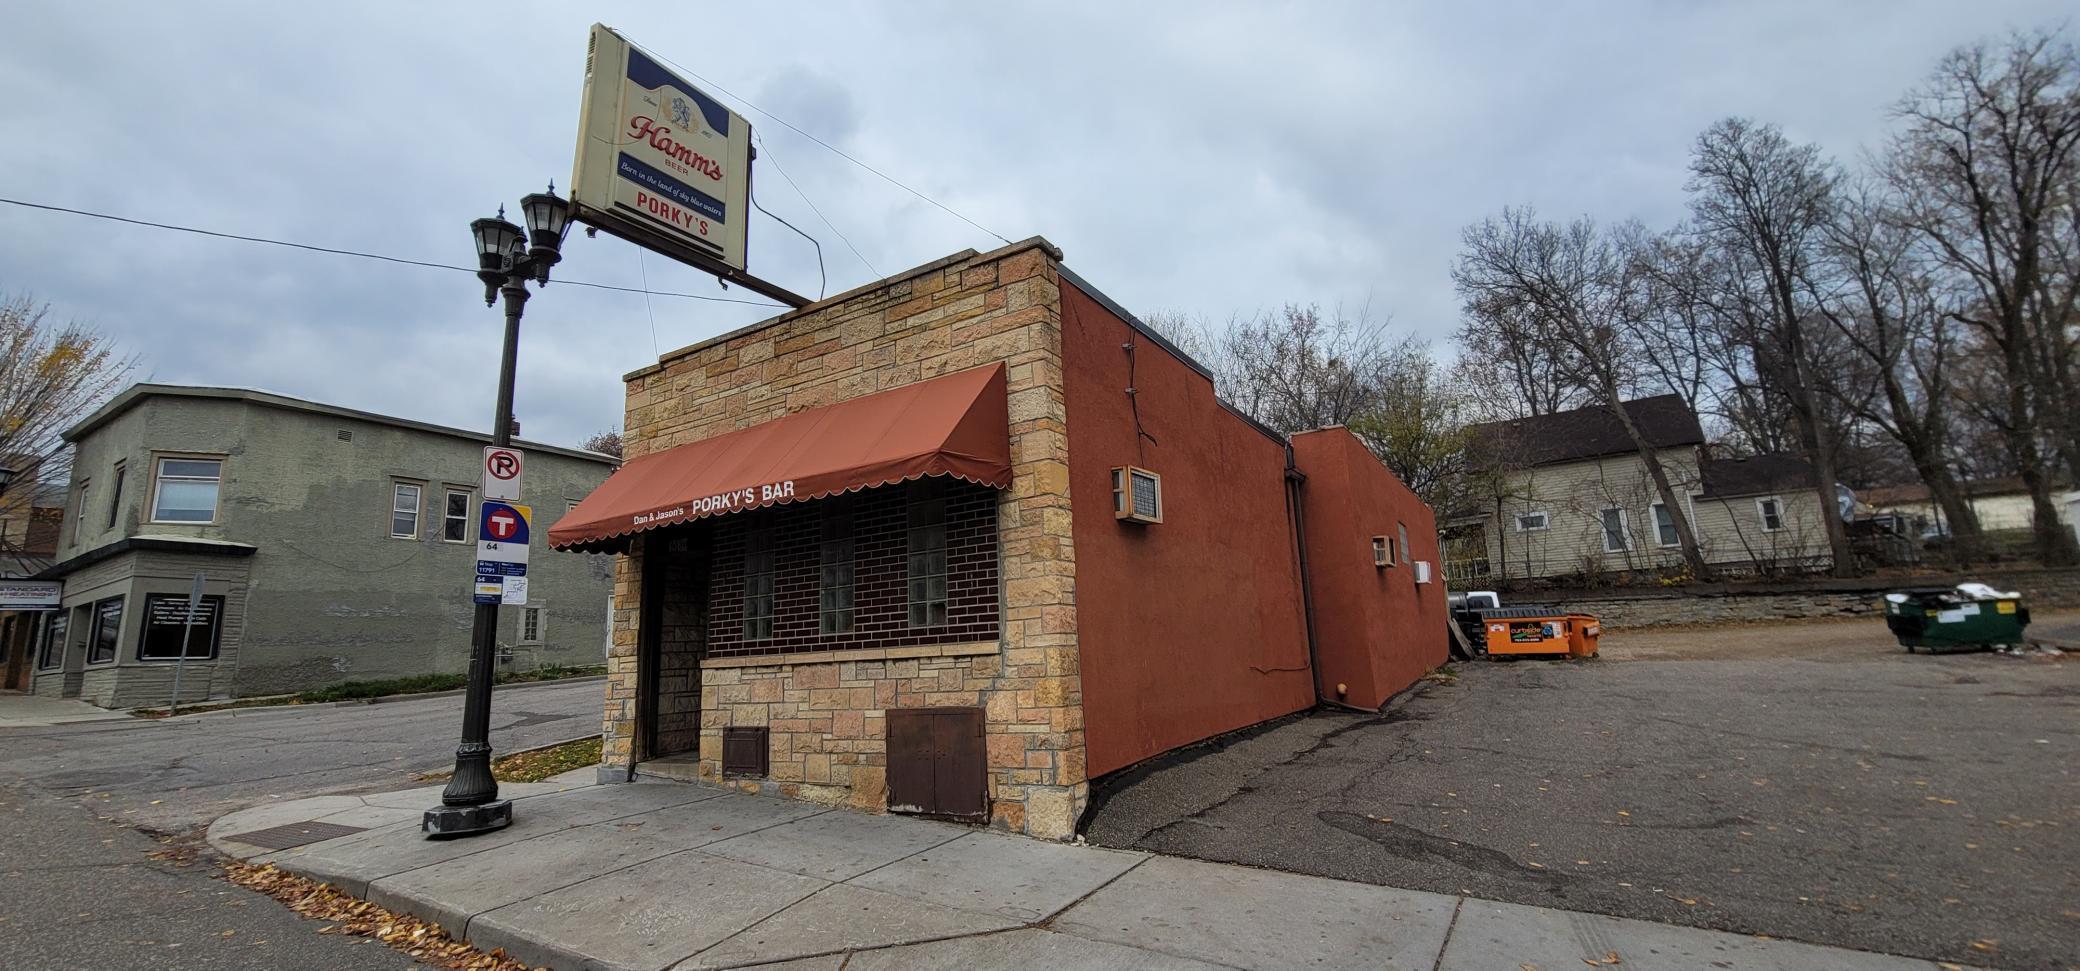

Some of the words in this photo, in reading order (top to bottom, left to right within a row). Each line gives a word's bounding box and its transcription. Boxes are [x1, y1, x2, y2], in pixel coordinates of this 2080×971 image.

[626, 115, 723, 181] Hamm's
[664, 158, 689, 176] BEER
[621, 161, 638, 176] Born
[638, 171, 646, 180] in
[646, 175, 658, 186] the
[657, 180, 673, 193] land
[672, 186, 681, 197] of
[679, 190, 690, 202] sky
[690, 195, 703, 208] blue
[702, 203, 722, 217] waters
[636, 191, 708, 236] PORKY'S
[633, 515, 649, 525] Dan
[648, 512, 655, 522] &
[655, 506, 685, 521] Jason's
[692, 487, 755, 515] PORKY'S
[762, 480, 795, 501] BAR
